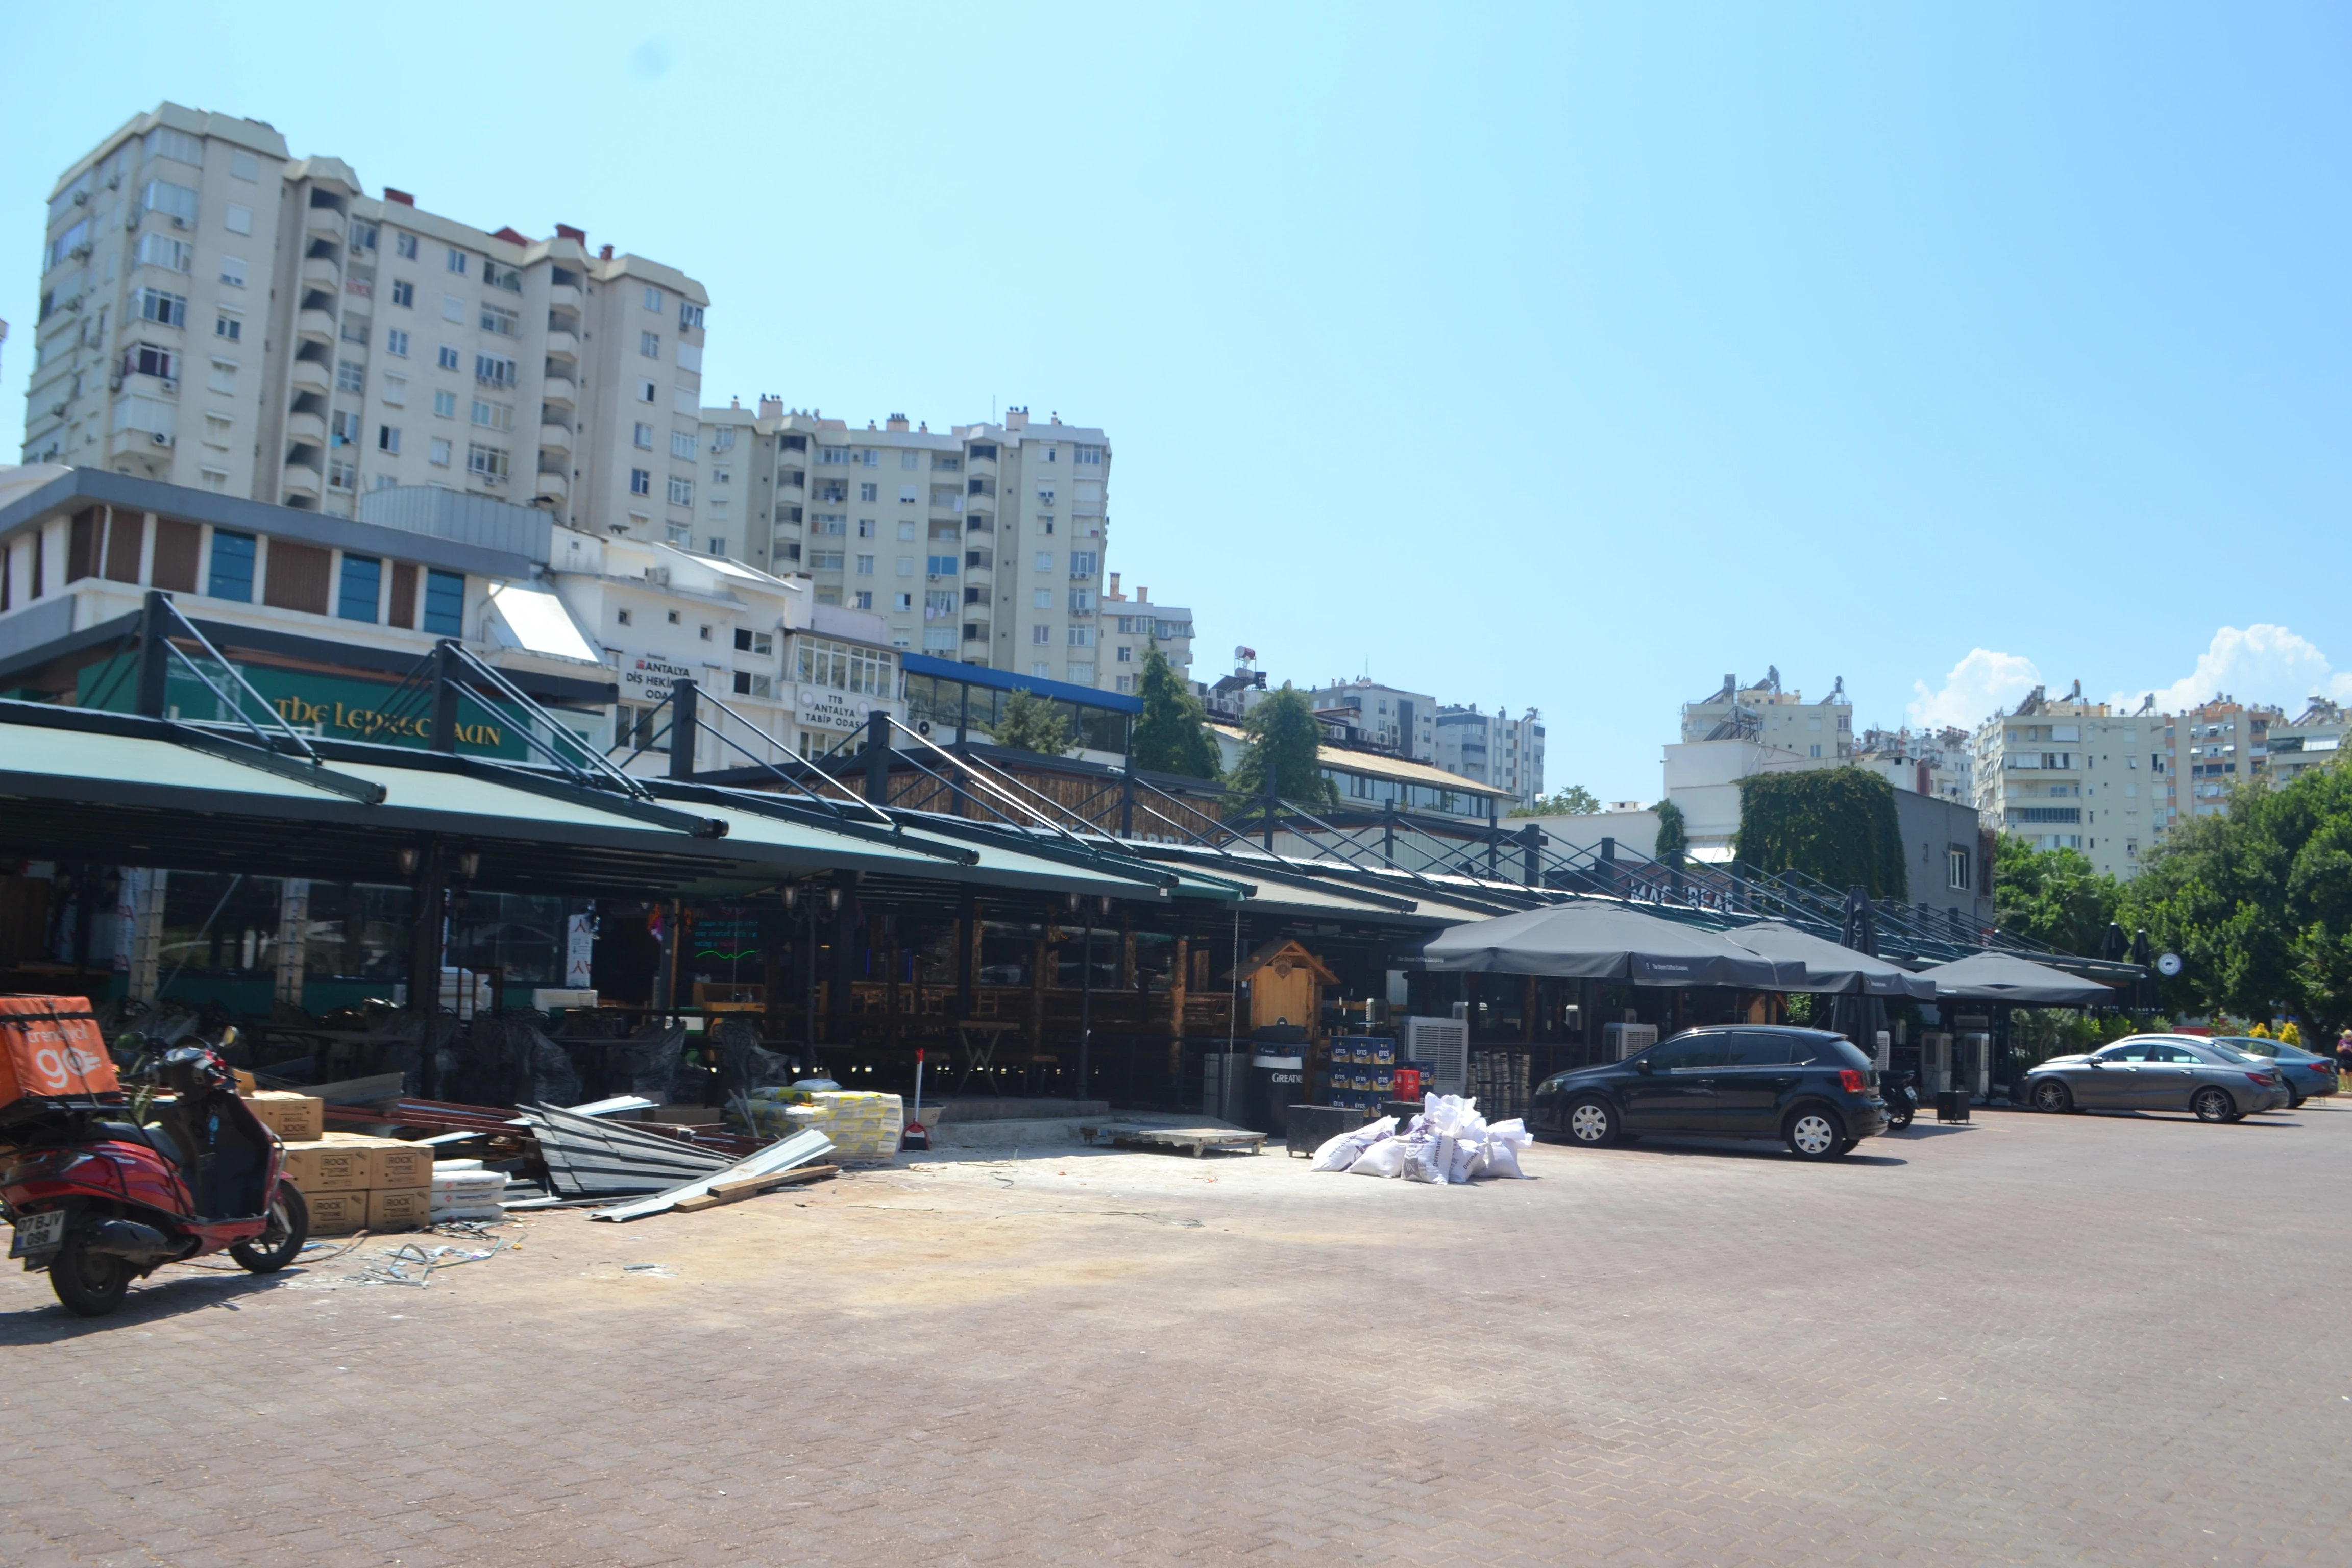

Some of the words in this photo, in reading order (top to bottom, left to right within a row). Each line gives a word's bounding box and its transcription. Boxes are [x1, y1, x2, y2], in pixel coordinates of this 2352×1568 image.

[645, 662, 690, 677] ANTALYA
[626, 671, 642, 685] DİŞ
[828, 695, 843, 704] TTB
[814, 704, 855, 717] ANTALYA
[805, 713, 831, 724] TABİP
[1433, 1141, 1442, 1167] Derman
[324, 1158, 349, 1166] ROCK
[388, 1156, 413, 1164] ROCK
[317, 1202, 342, 1210] ROCK
[387, 1198, 411, 1206] ROCK
[18, 1218, 34, 1232] 07
[35, 1212, 62, 1229] BJV
